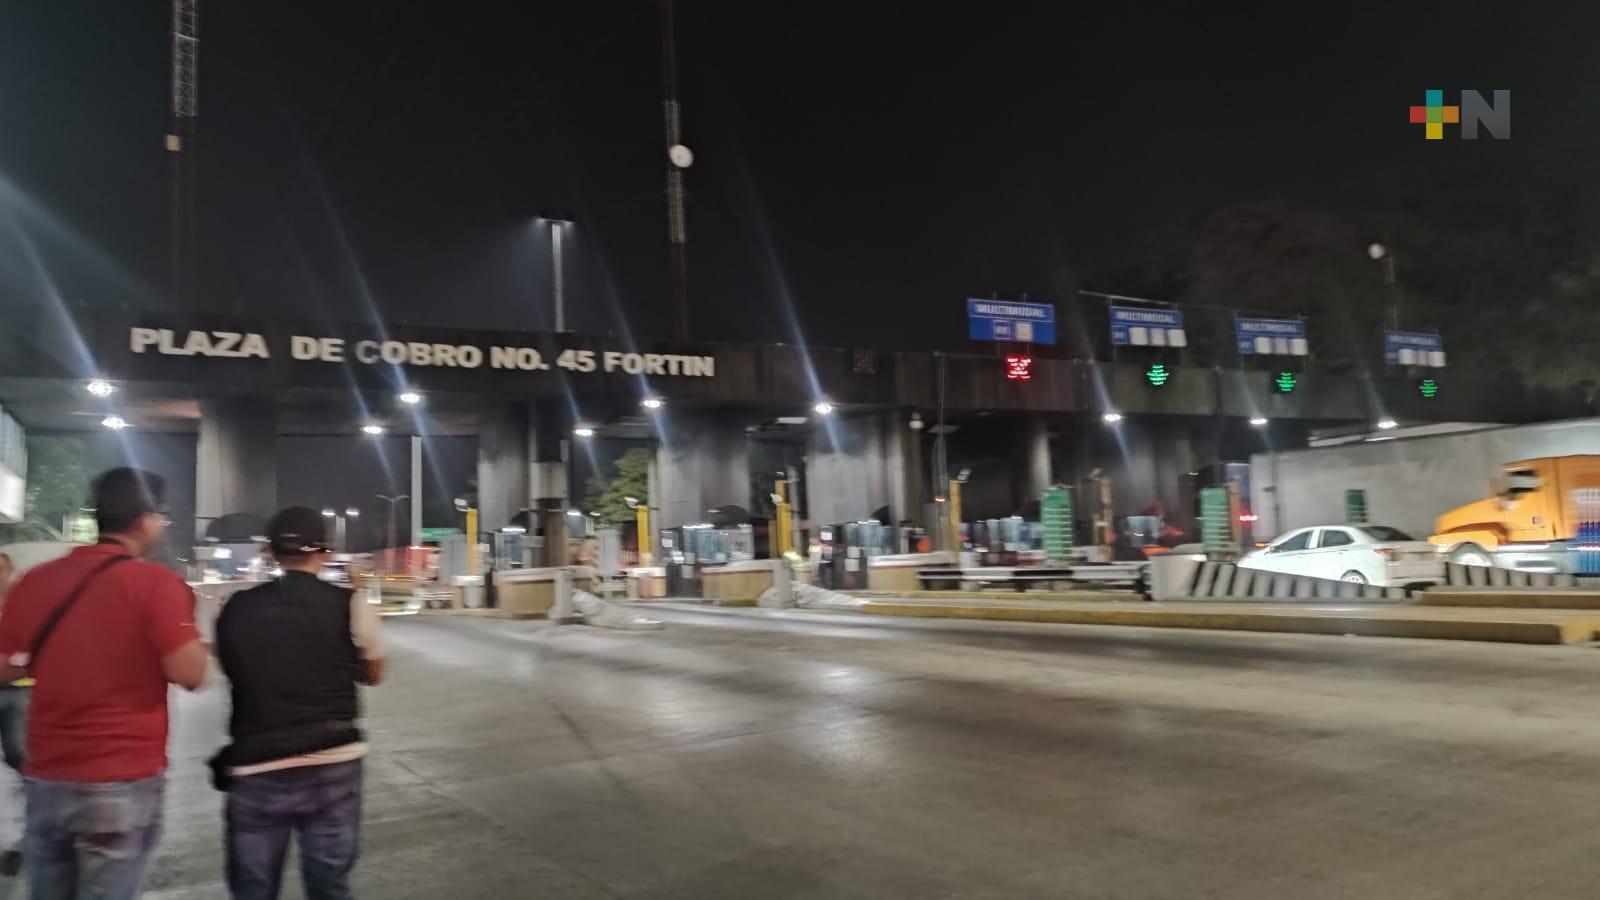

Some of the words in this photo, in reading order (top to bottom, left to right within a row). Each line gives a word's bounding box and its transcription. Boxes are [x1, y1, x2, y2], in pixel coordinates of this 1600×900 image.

[974, 303, 1046, 318] MULTIMODAL
[1114, 311, 1174, 323] MULTIMODAL
[130, 326, 269, 359] PLAZA
[291, 335, 344, 363] DE
[356, 340, 483, 369] COBRO
[490, 347, 548, 371] NO.
[556, 349, 595, 373] 45
[604, 351, 715, 378] FORTIN
